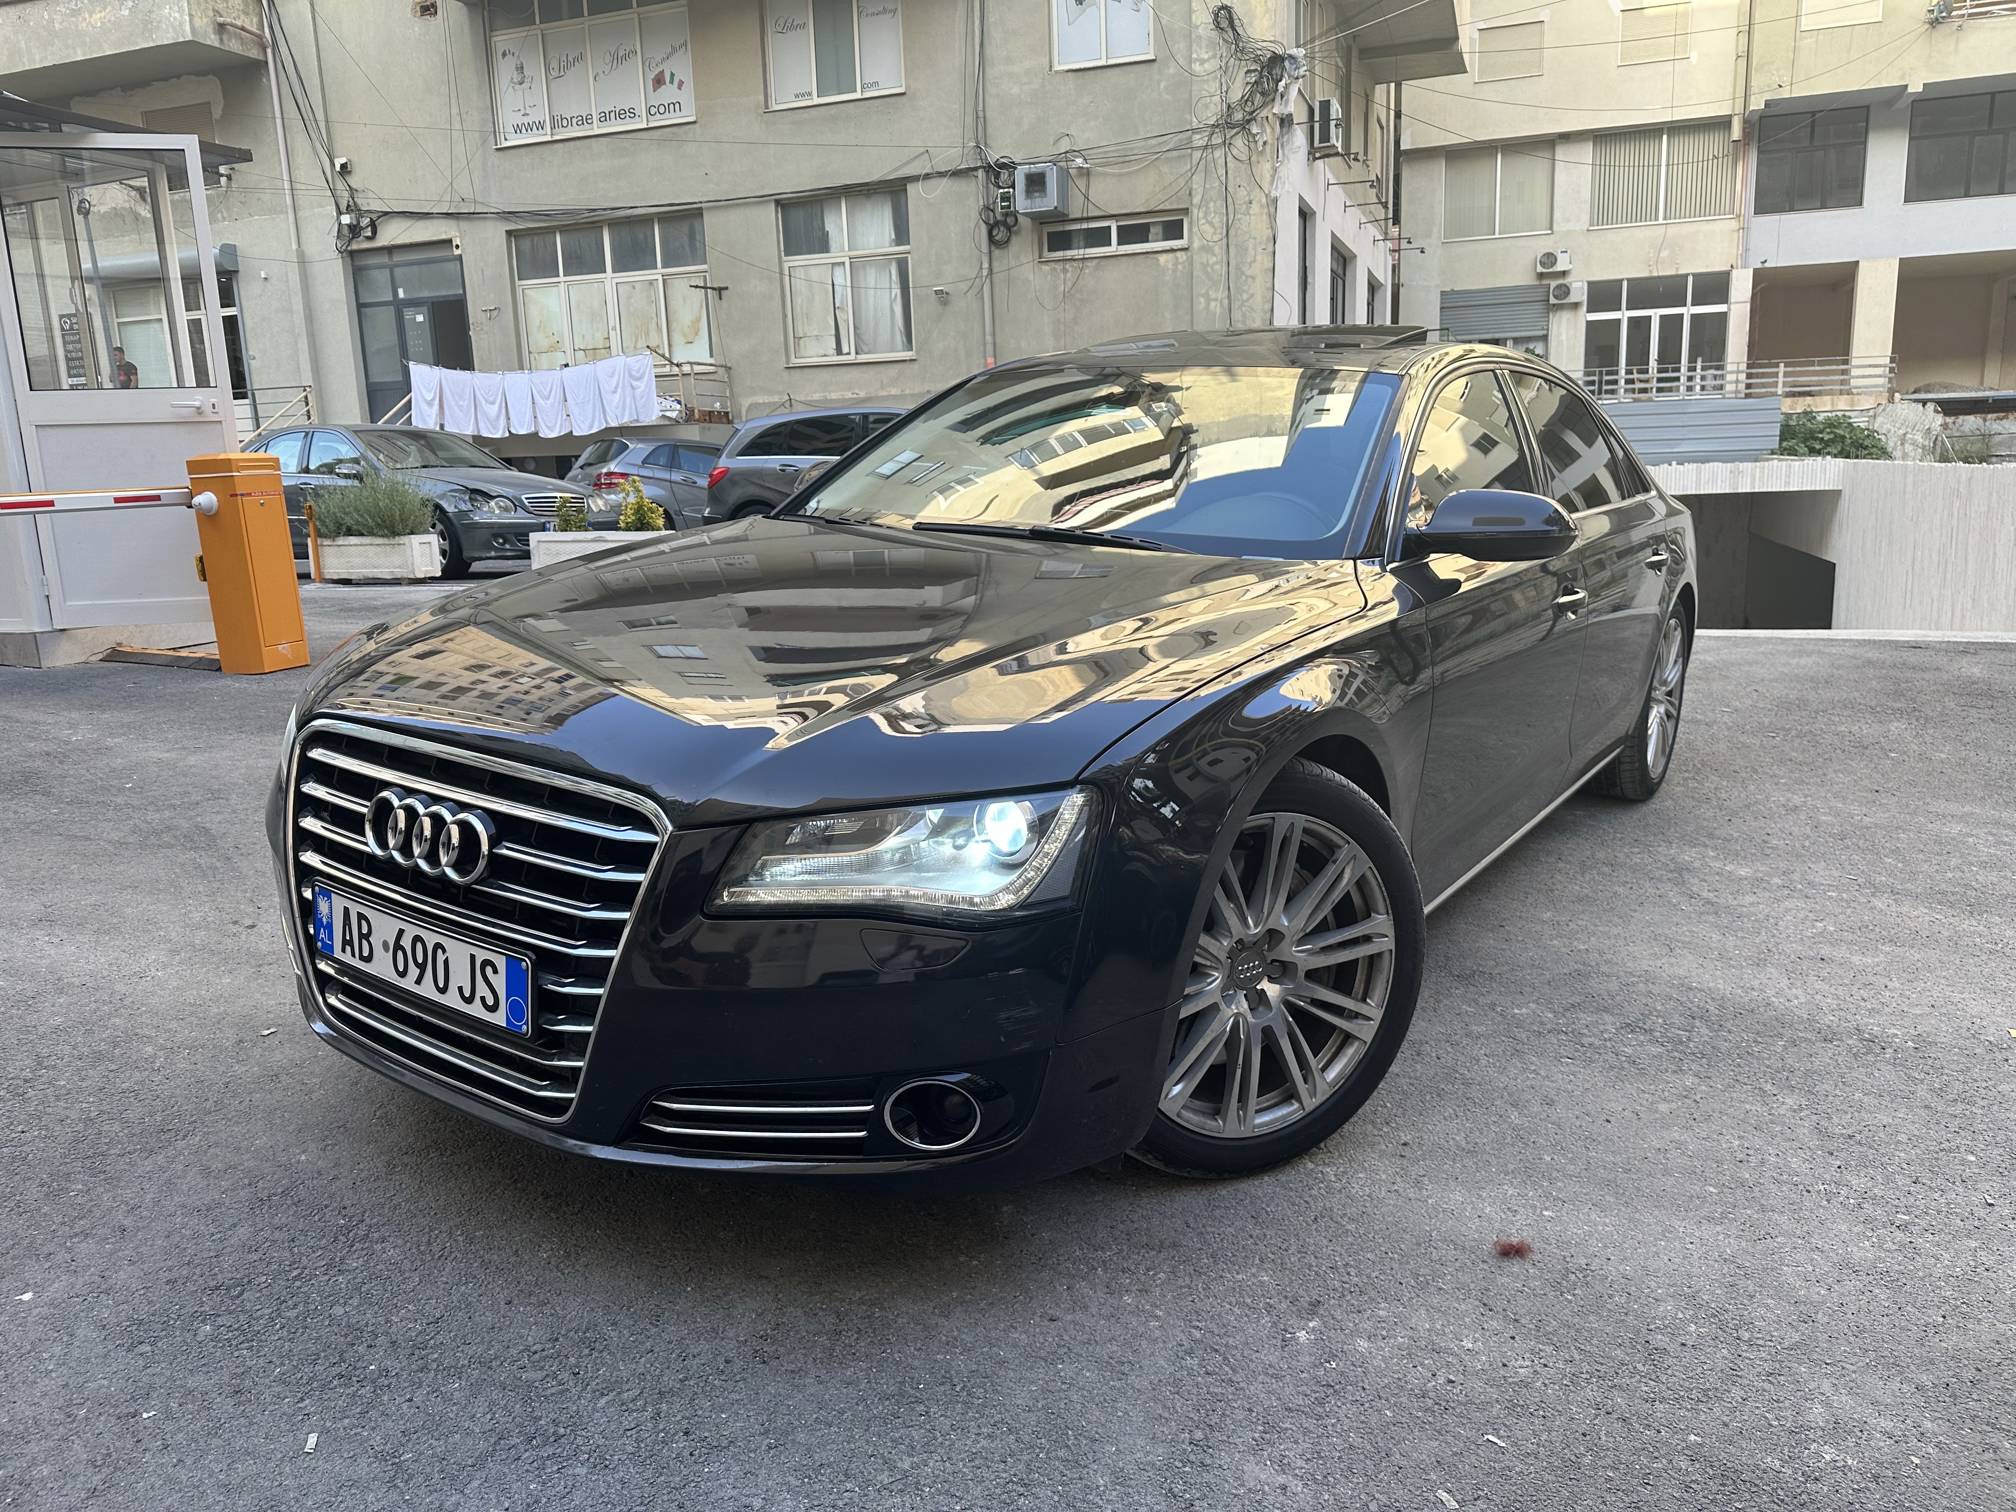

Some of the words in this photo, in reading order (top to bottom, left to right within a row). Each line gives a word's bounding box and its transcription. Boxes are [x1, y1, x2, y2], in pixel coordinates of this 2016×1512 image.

[773, 16, 807, 34] Libra
[547, 51, 584, 80] Libra
[601, 42, 638, 77] Aries
[644, 39, 688, 73] Consulting
[318, 927, 332, 945] AL
[340, 905, 374, 963] AB
[391, 927, 450, 995] 690
[456, 952, 501, 1013] JS
